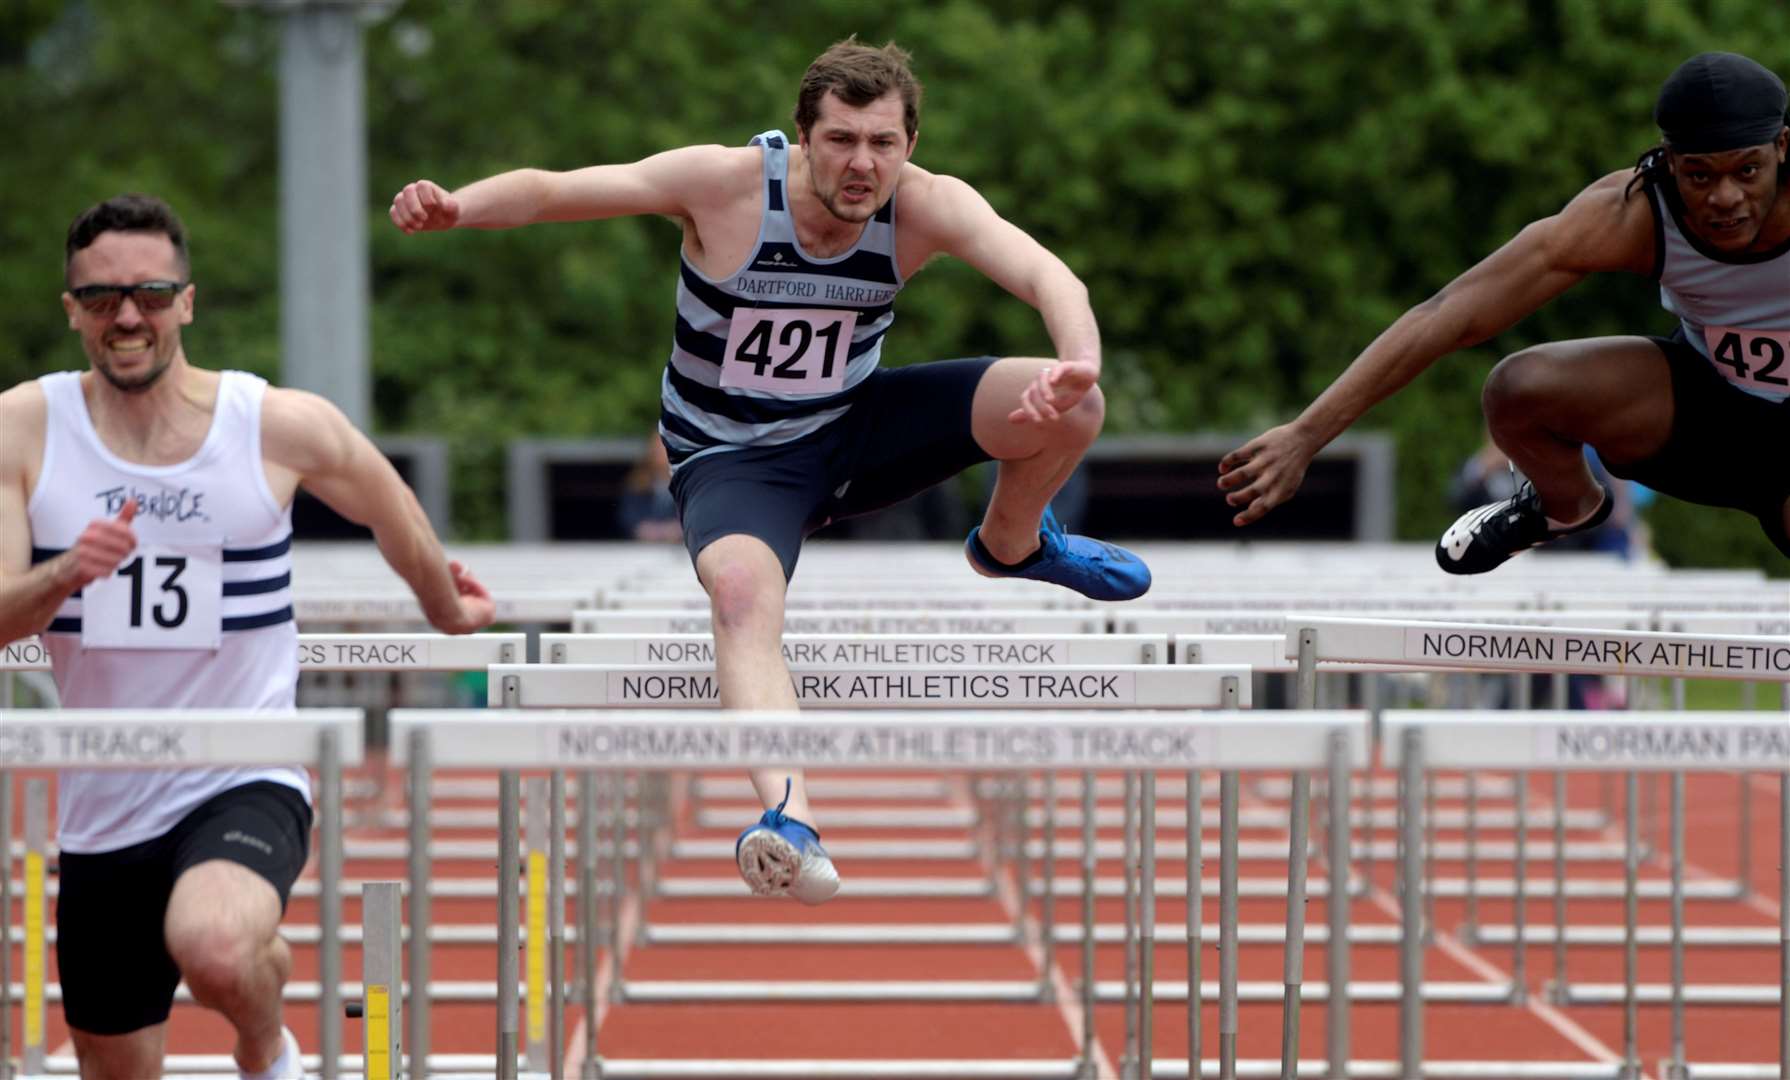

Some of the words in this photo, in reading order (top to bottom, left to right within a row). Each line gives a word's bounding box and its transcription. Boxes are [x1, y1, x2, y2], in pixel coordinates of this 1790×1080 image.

[736, 277, 816, 298] DARTFORD
[825, 284, 896, 303] HARRIER
[734, 319, 842, 379] 421
[1714, 331, 1790, 386] 42
[117, 556, 189, 629] 13
[784, 619, 822, 633] ARK
[949, 619, 1015, 633] TRACK
[333, 645, 416, 663] TRACK
[781, 644, 827, 662] ARK
[833, 644, 965, 663] ATHLETICS
[973, 644, 1056, 663] TRACK
[1423, 633, 1554, 661] NORMAN
[1565, 639, 1643, 665] PARK
[848, 675, 1010, 699] ATHLETICS
[1018, 675, 1120, 699] TRACK
[55, 727, 186, 758] TRACK
[559, 726, 730, 758] NORMAN
[739, 726, 841, 758] PARK
[849, 727, 1057, 758] ATHLETICS
[1071, 727, 1196, 758] TRACK
[1557, 725, 1728, 758] NORMAN
